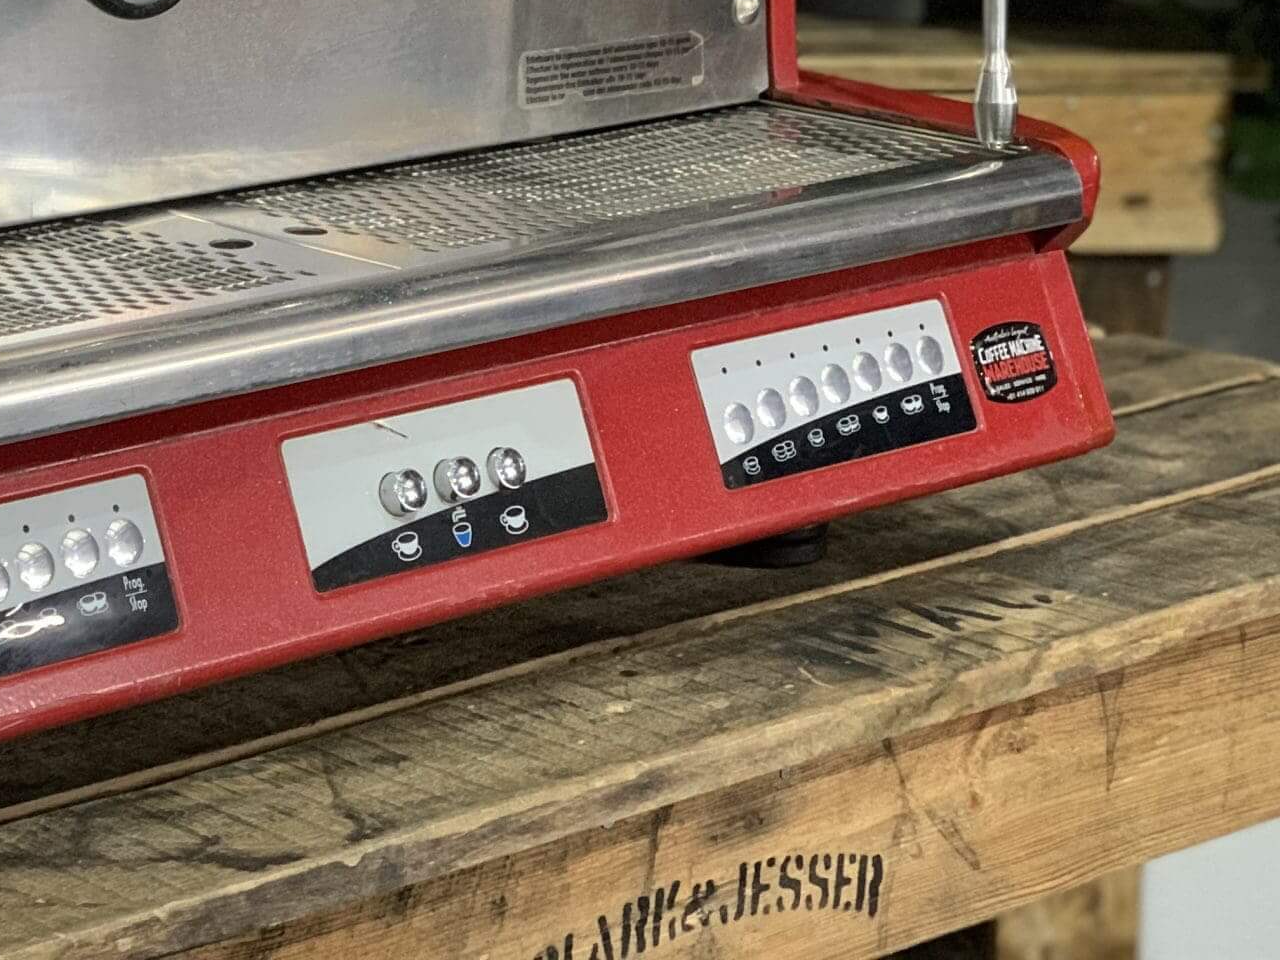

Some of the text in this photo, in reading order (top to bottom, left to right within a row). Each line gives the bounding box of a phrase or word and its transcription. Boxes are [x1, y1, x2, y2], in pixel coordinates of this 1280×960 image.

[978, 342, 1011, 365] COFFEE
[122, 575, 145, 592] Prog.
[129, 595, 148, 612] Stop
